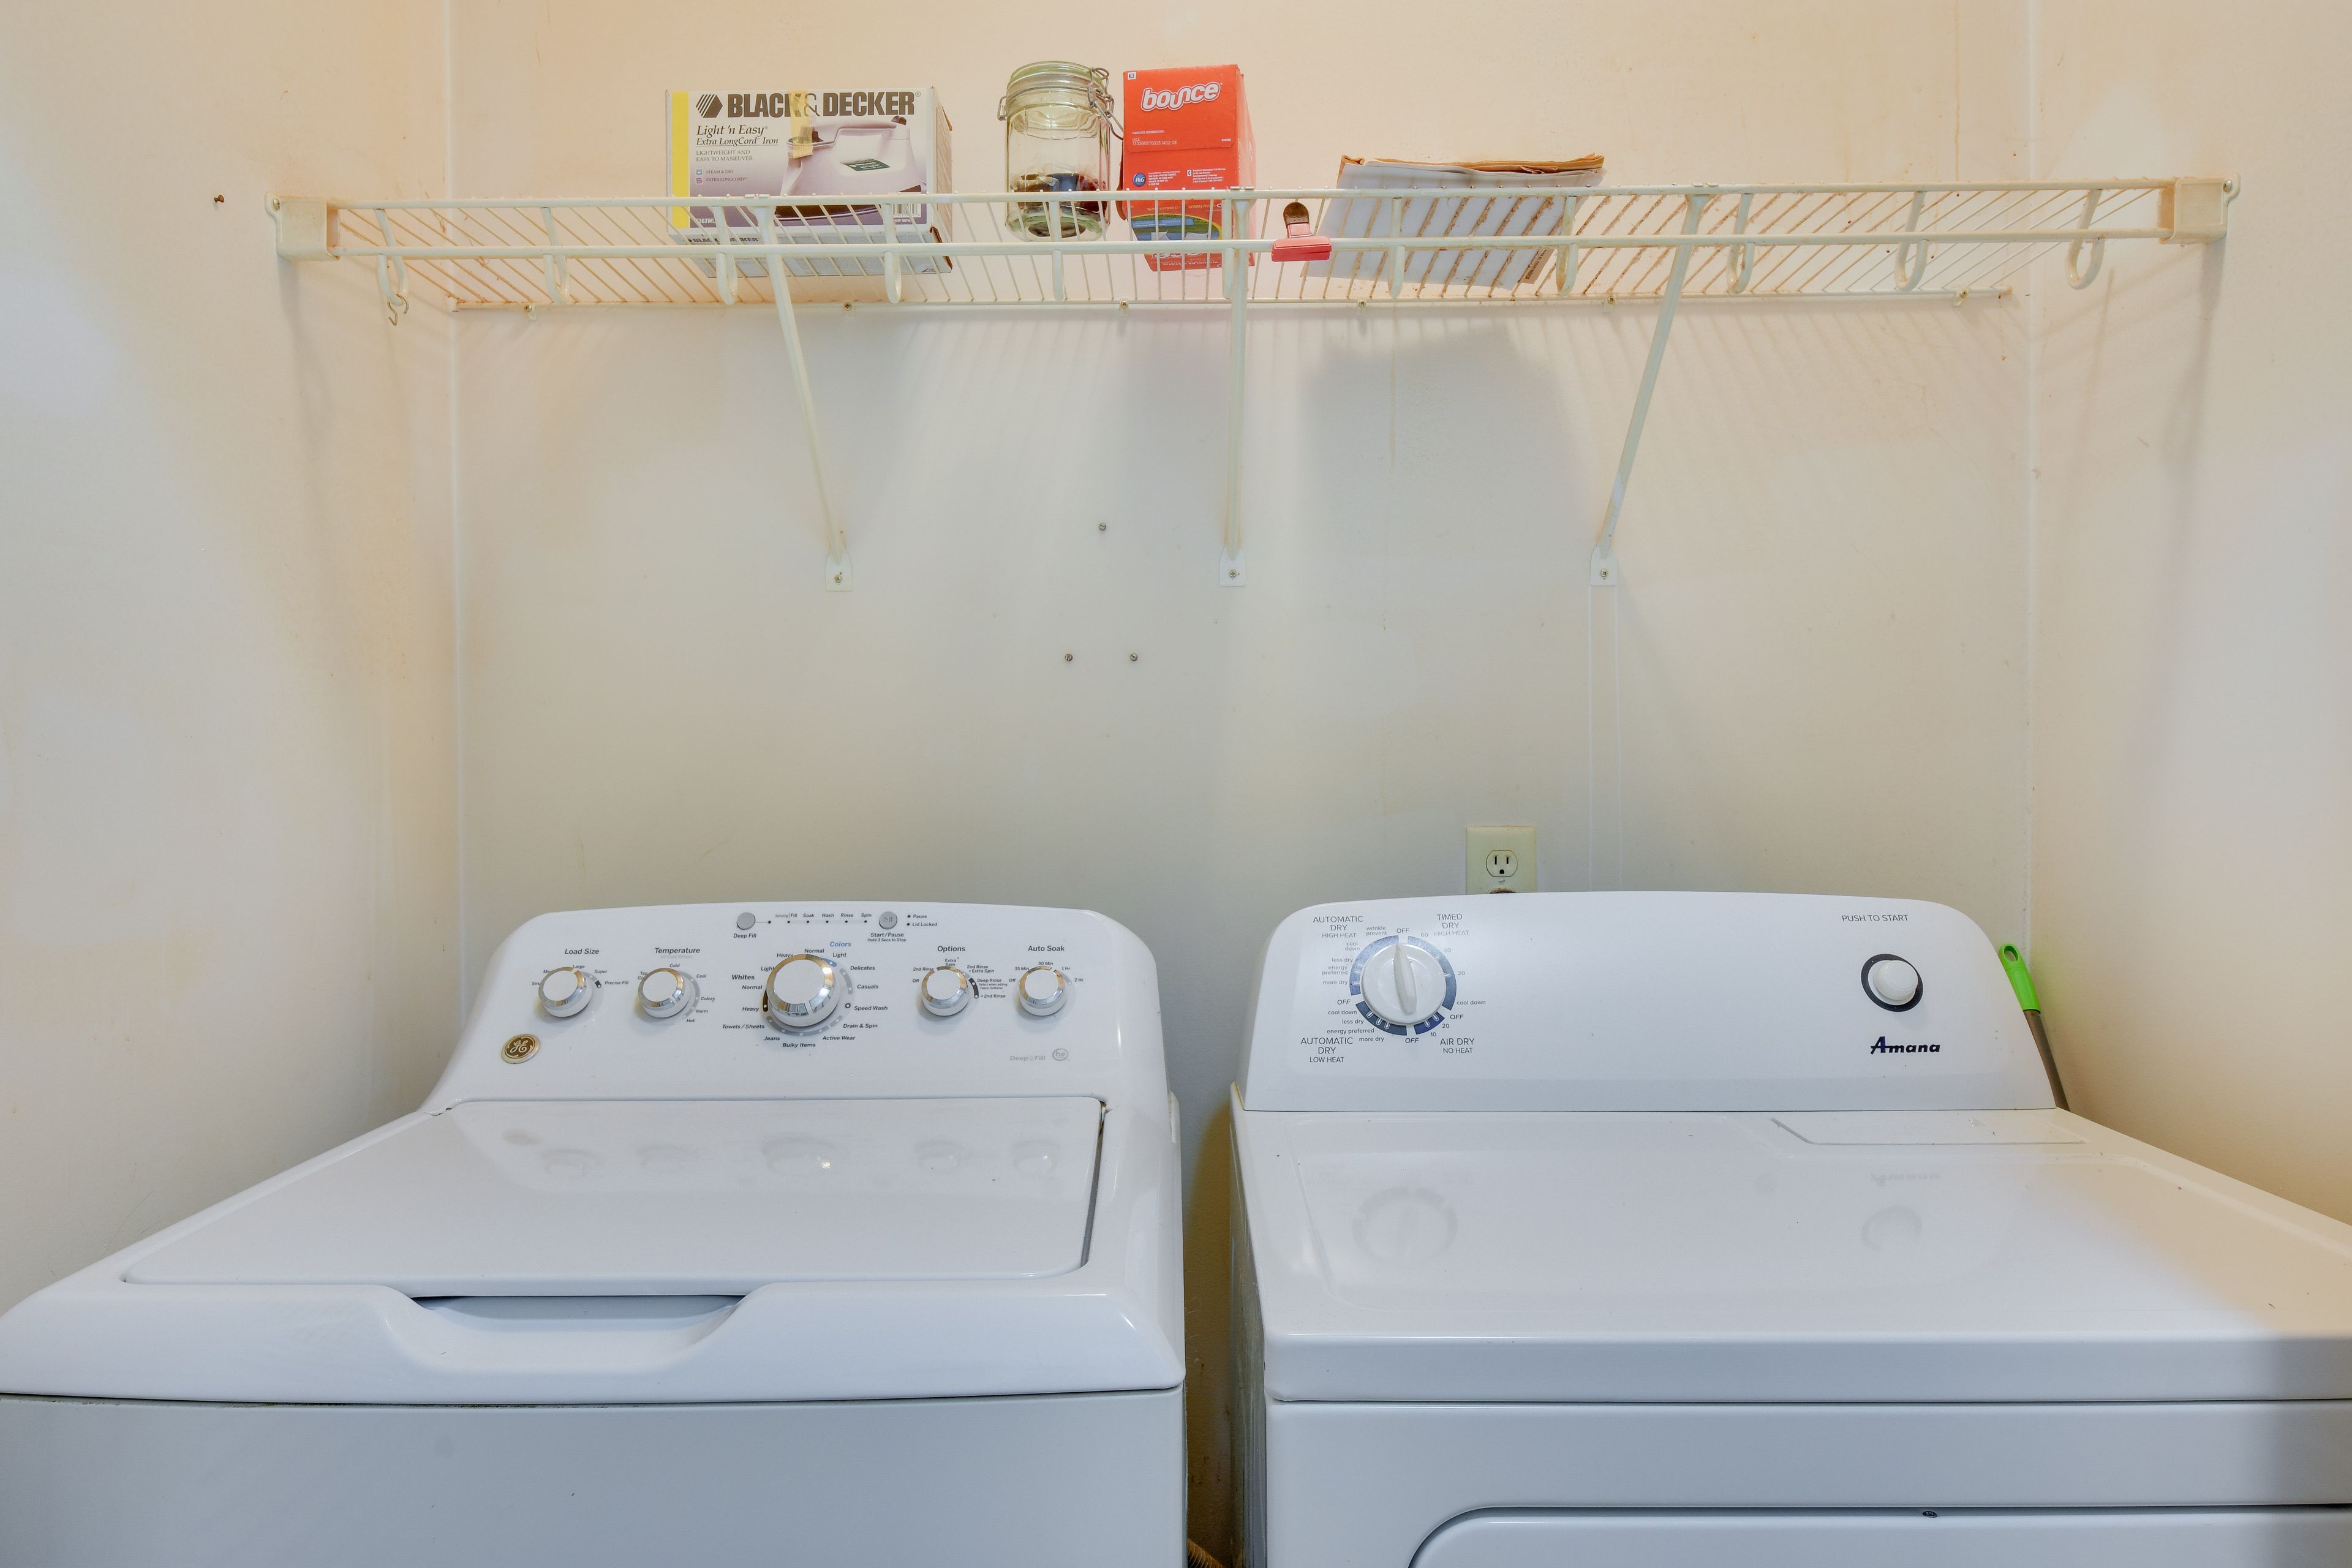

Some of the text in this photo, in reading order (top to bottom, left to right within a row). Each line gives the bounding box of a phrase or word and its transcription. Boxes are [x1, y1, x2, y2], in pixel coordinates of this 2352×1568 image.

[728, 93, 802, 118] BLACK
[823, 92, 914, 116] DECKER
[1141, 82, 1221, 111] bounce
[697, 125, 725, 138] Light
[739, 124, 764, 137] Easy
[1870, 1036, 1940, 1055] Amana
